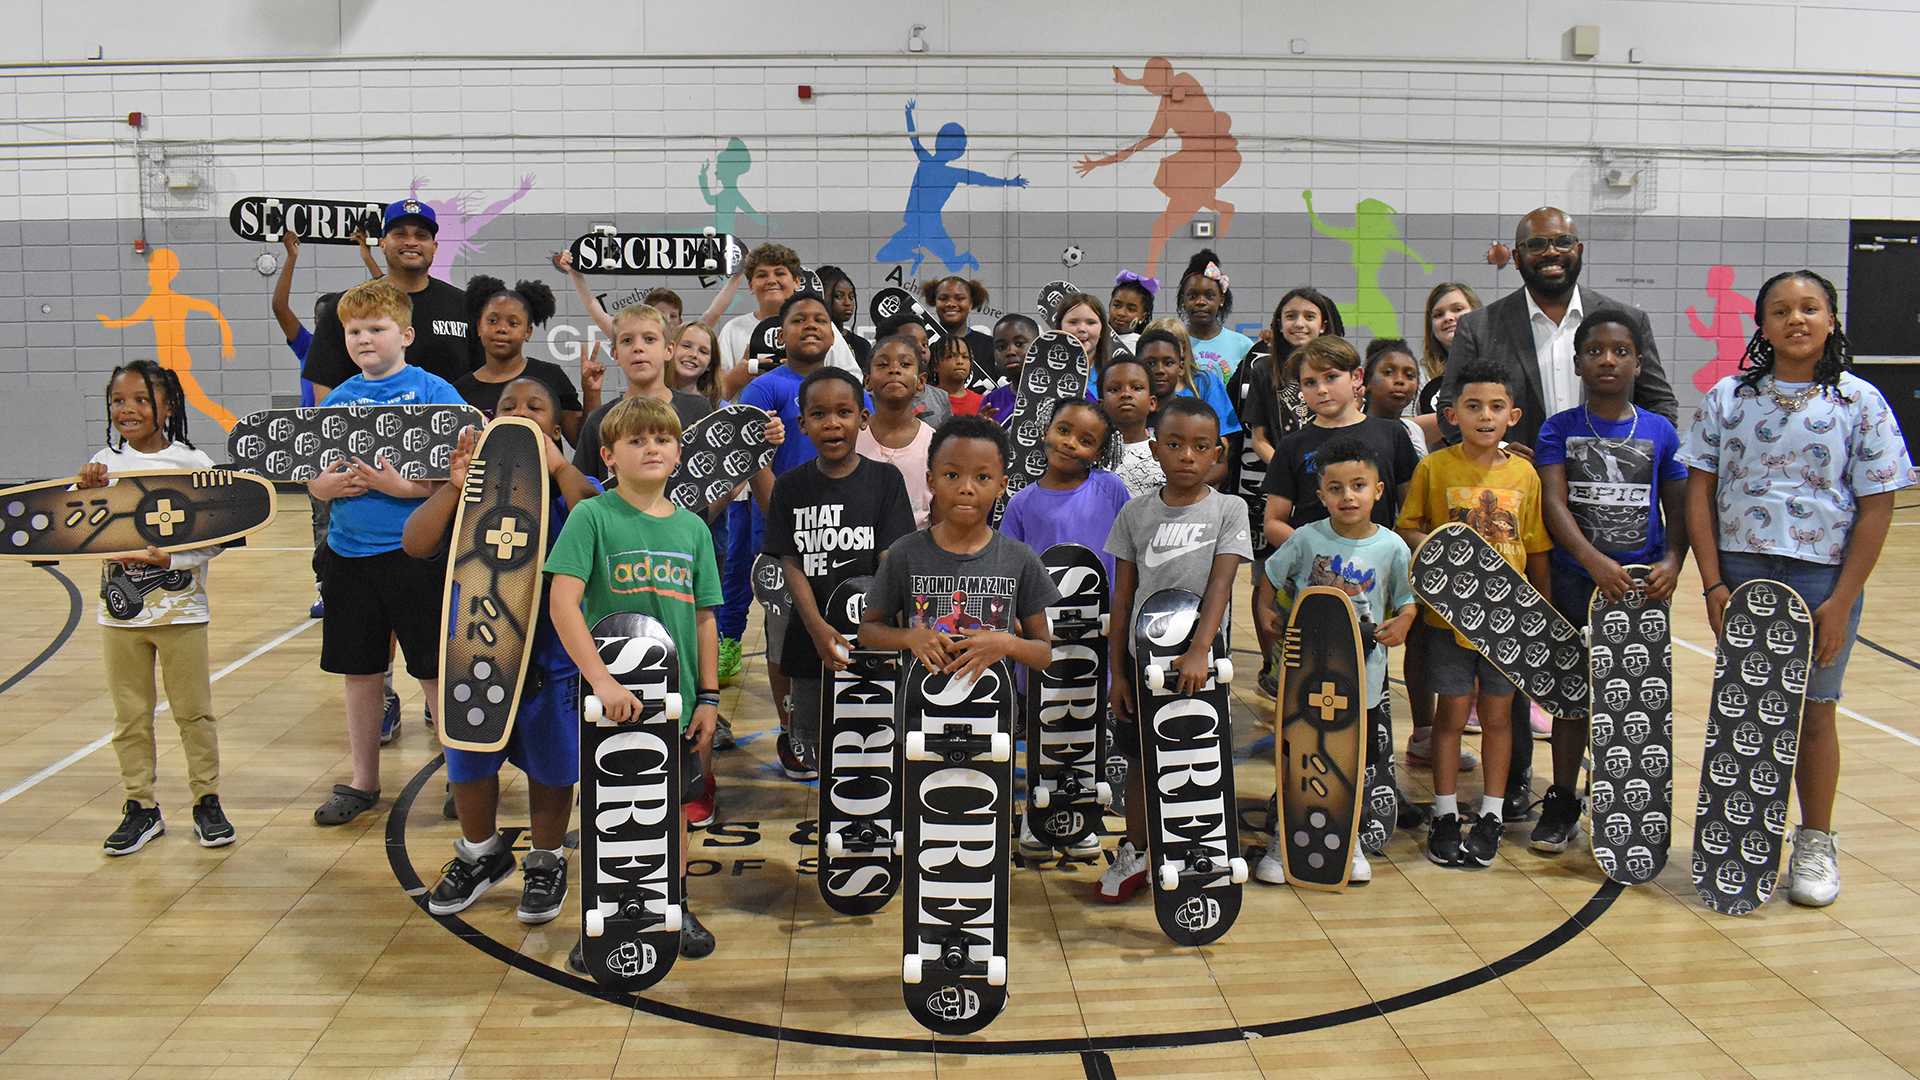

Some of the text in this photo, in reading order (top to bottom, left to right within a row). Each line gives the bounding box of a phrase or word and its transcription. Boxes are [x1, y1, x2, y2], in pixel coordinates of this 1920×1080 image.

[976, 306, 1002, 319] ore
[432, 320, 468, 338] SECRET
[1573, 485, 1647, 502] EPIC
[793, 504, 844, 530] THAT
[793, 526, 875, 553] SWOOSH
[1152, 523, 1206, 547] NIKE
[614, 556, 692, 587] addas
[957, 576, 1016, 595] AMAZING
